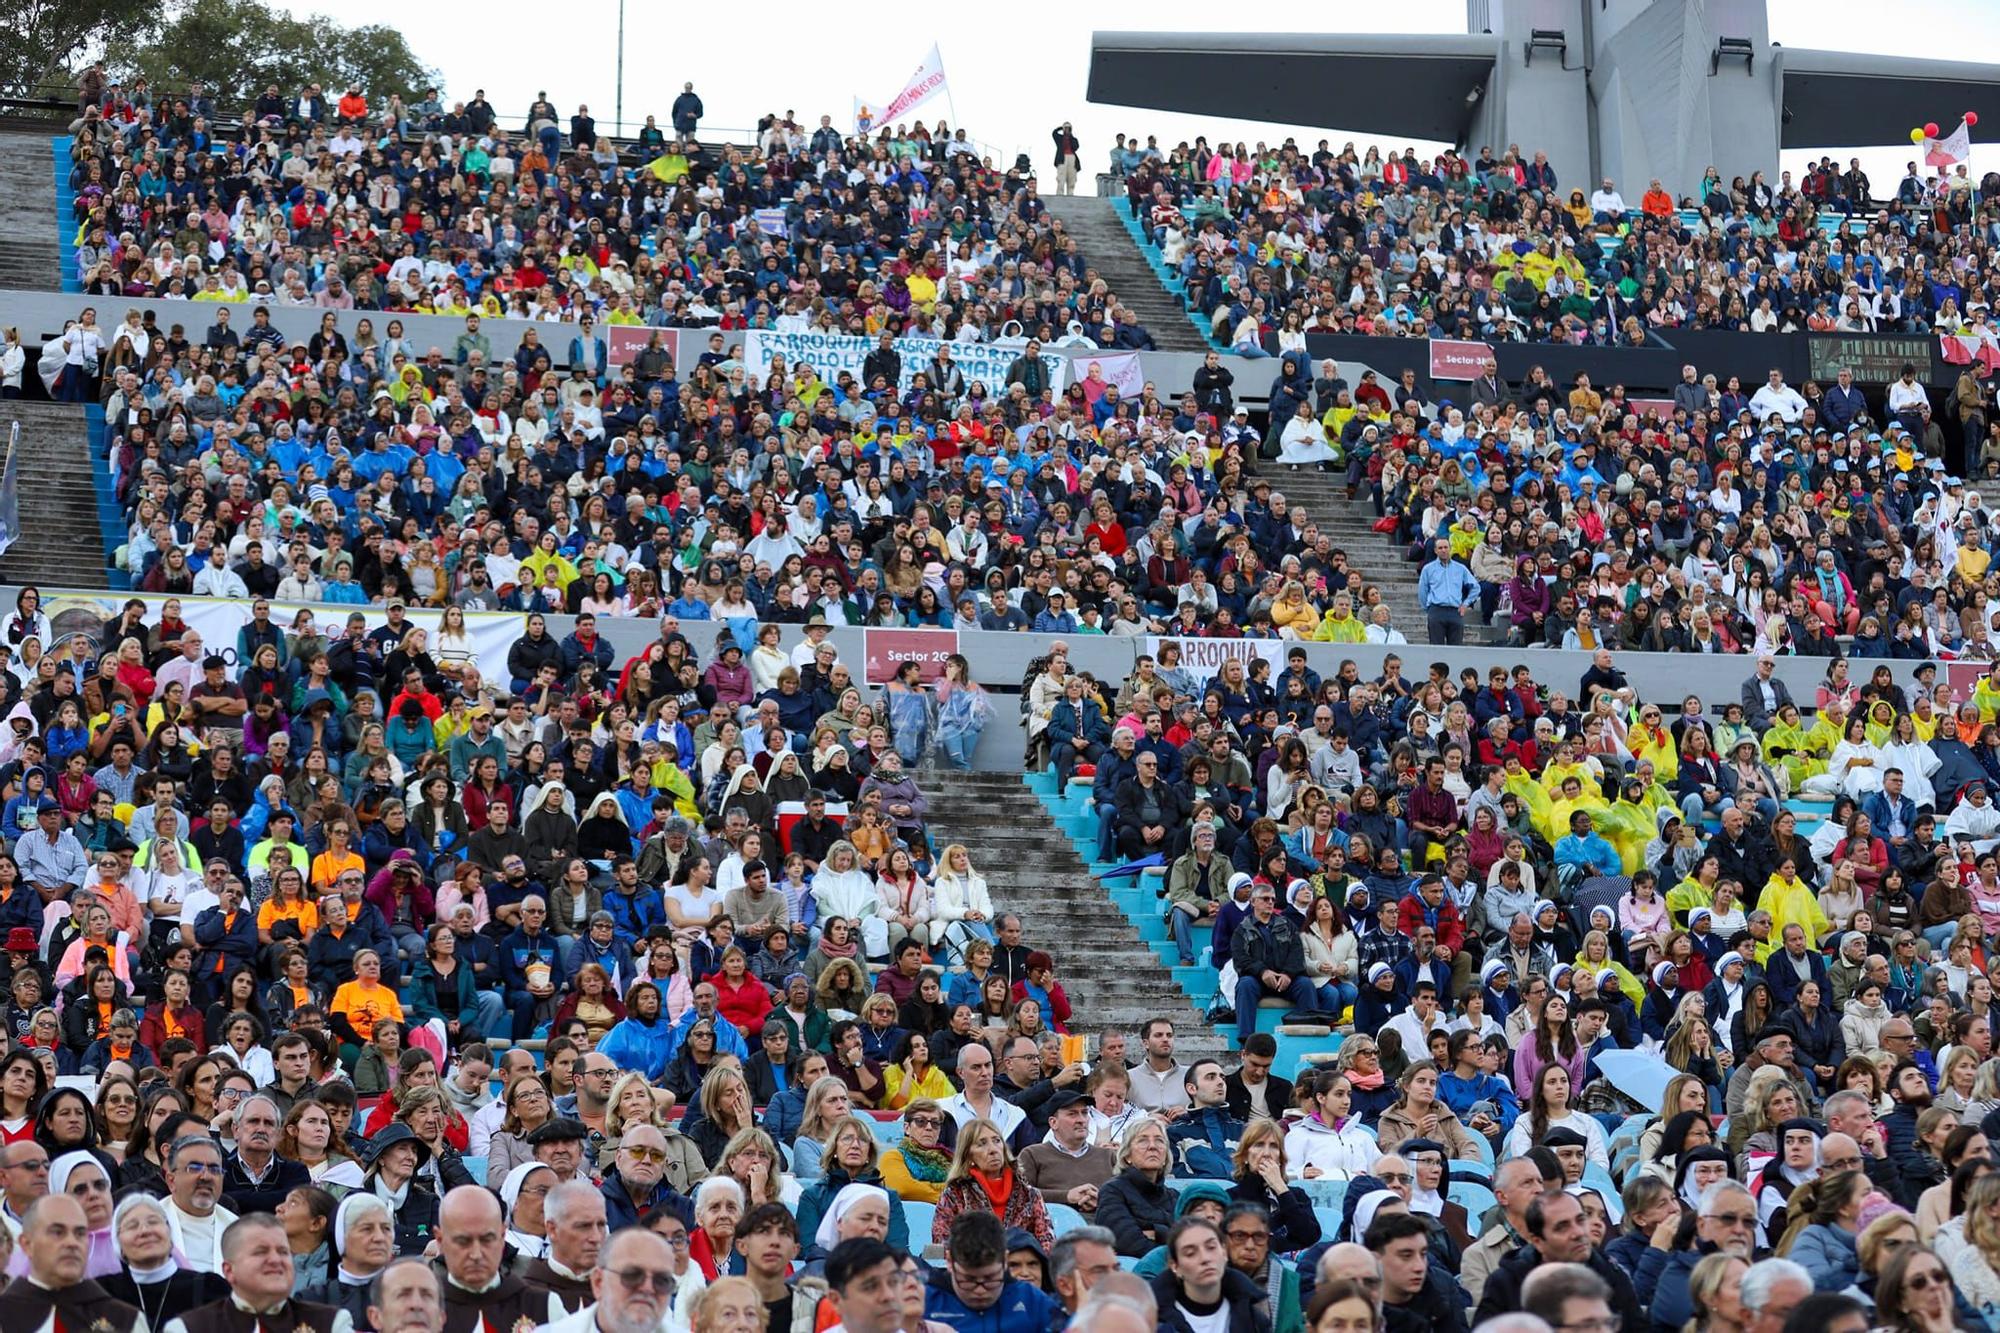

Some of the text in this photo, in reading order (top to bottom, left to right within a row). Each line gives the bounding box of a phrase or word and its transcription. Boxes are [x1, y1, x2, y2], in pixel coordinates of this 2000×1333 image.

[759, 333, 871, 351] PARROQUIA
[1446, 355, 1474, 365] Sector
[887, 650, 929, 662] Sector
